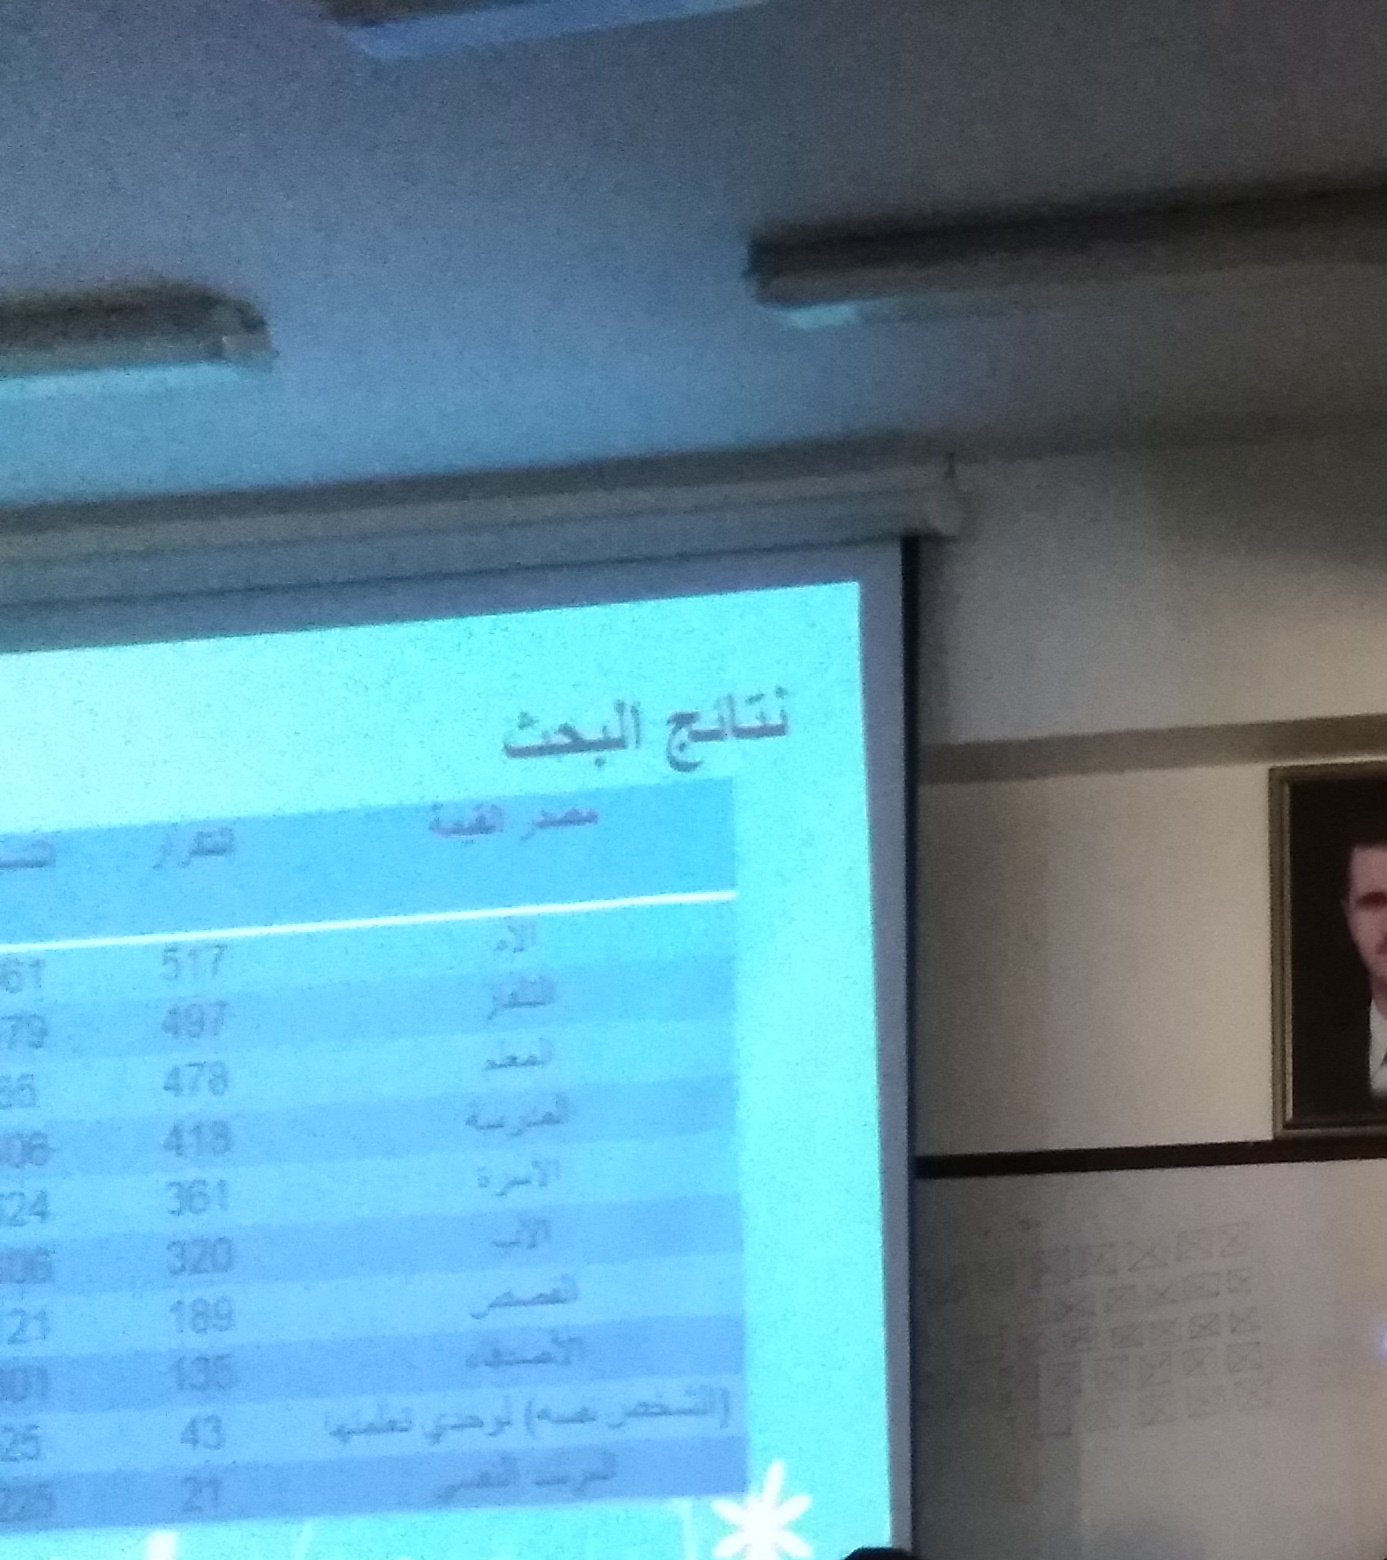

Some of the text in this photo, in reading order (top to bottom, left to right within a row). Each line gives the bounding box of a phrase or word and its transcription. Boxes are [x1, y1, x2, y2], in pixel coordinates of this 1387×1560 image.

[503, 686, 788, 773] نتائج البحث
[427, 802, 601, 846] مصدر القيمة
[161, 941, 230, 983] 517
[161, 999, 230, 1041] 497
[162, 1059, 232, 1098] 478
[162, 1118, 235, 1158] 418
[165, 1178, 230, 1217] 361
[165, 1237, 235, 1277] 320
[169, 1296, 237, 1336] 189
[169, 1353, 239, 1394] 135
[179, 1413, 227, 1453] 43
